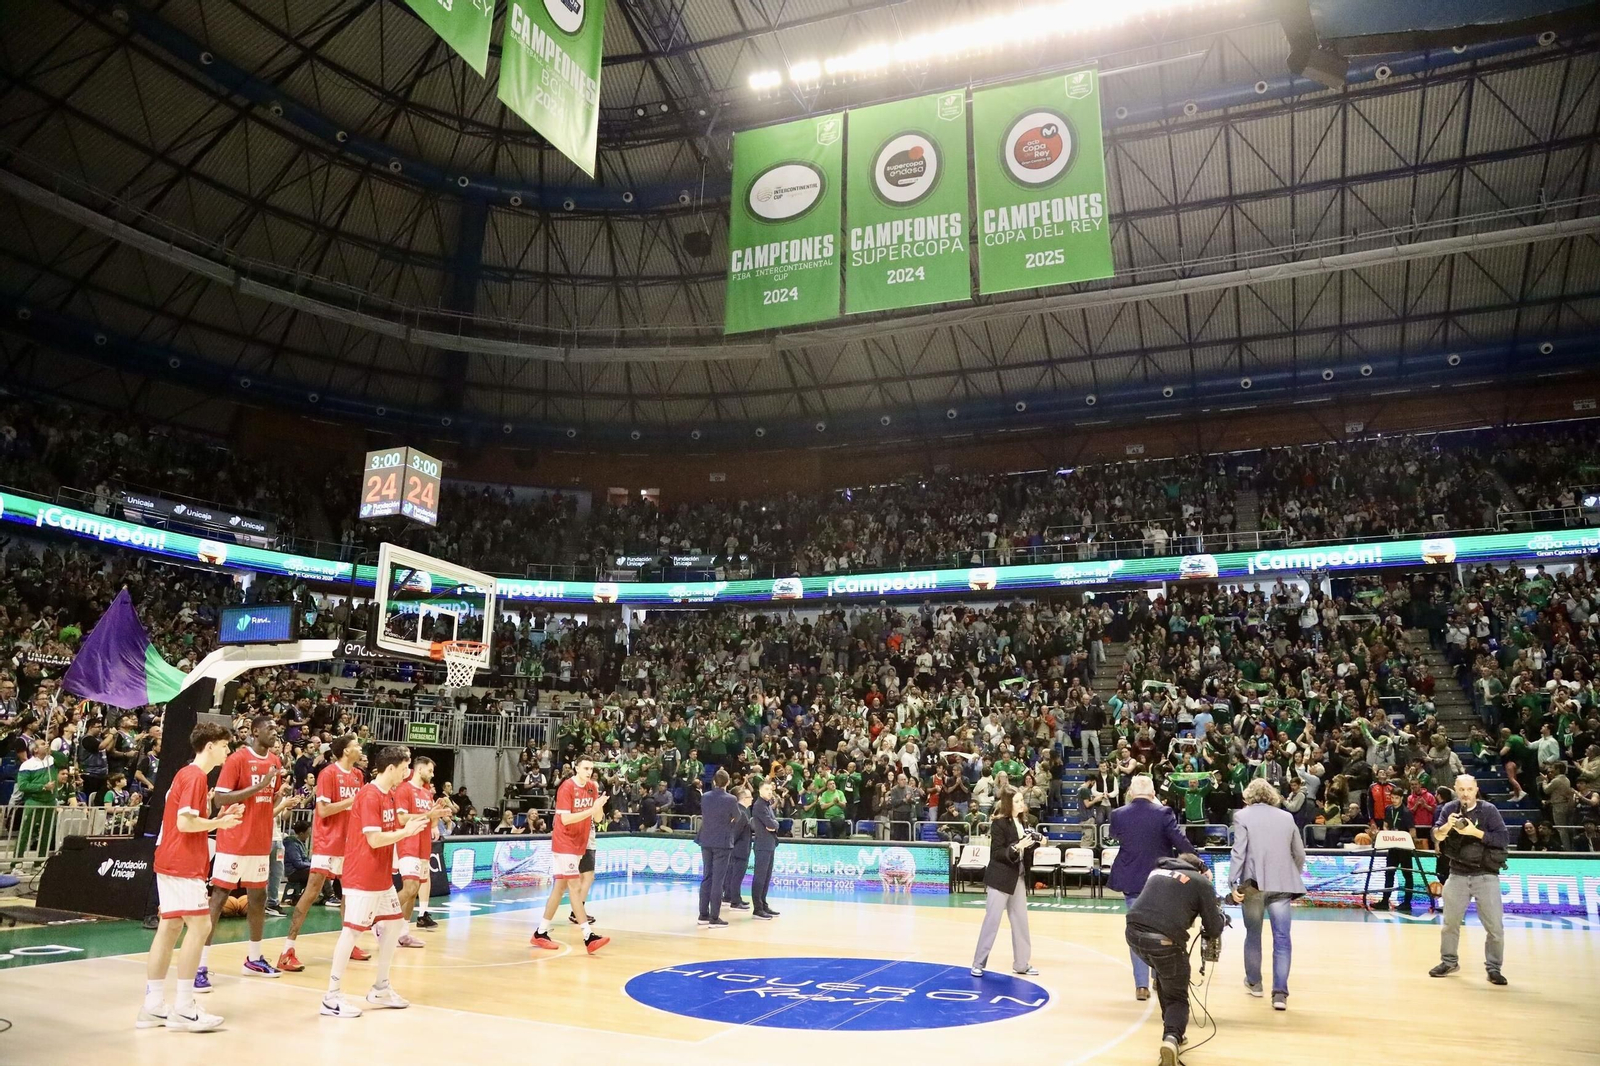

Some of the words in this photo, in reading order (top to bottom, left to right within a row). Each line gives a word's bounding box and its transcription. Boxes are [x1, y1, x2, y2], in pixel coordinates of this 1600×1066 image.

[511, 3, 596, 105] CAMPEONES
[541, 68, 566, 101] BCL
[1022, 143, 1046, 152] Copa
[1034, 150, 1050, 158] Rey
[887, 160, 924, 171] supercopa
[890, 166, 924, 177] endesa
[984, 193, 1103, 234] CAMPEONES
[851, 212, 962, 252] CAMPEONES
[985, 231, 1027, 246] COPA
[1033, 224, 1064, 240] DEL
[1071, 218, 1103, 234] REY
[732, 233, 834, 273] CAMPEONES
[852, 237, 964, 267] SUPERCOPA
[1025, 248, 1065, 269] 2025
[732, 272, 751, 281] FIBA
[755, 259, 833, 277] INTERCONTINENTAL
[774, 272, 789, 282] CUP
[887, 266, 925, 285] 2024
[763, 286, 799, 305] 2024
[371, 452, 401, 469] 3:00
[412, 455, 438, 476] 3:00
[365, 472, 397, 503] 24
[406, 475, 434, 509] 24
[127, 496, 155, 508] Unicaja
[186, 508, 212, 521] Unicaja
[35, 507, 166, 550] ¡Campeón!
[240, 520, 265, 531] Unicaja
[1528, 540, 1563, 550] Copa
[1247, 546, 1383, 574] ¡Campeón!
[828, 573, 937, 596] ¡Campeón!
[27, 652, 71, 665] UNICAJA
[574, 797, 593, 808] BAXI
[1382, 834, 1406, 842] Wilson
[113, 859, 147, 870] Fundación
[812, 864, 831, 873] del
[833, 860, 866, 880] Rey
[111, 868, 136, 881] Unicaja
[773, 877, 795, 886] Gran
[797, 878, 833, 889] Canaria
[834, 879, 855, 889] 2025
